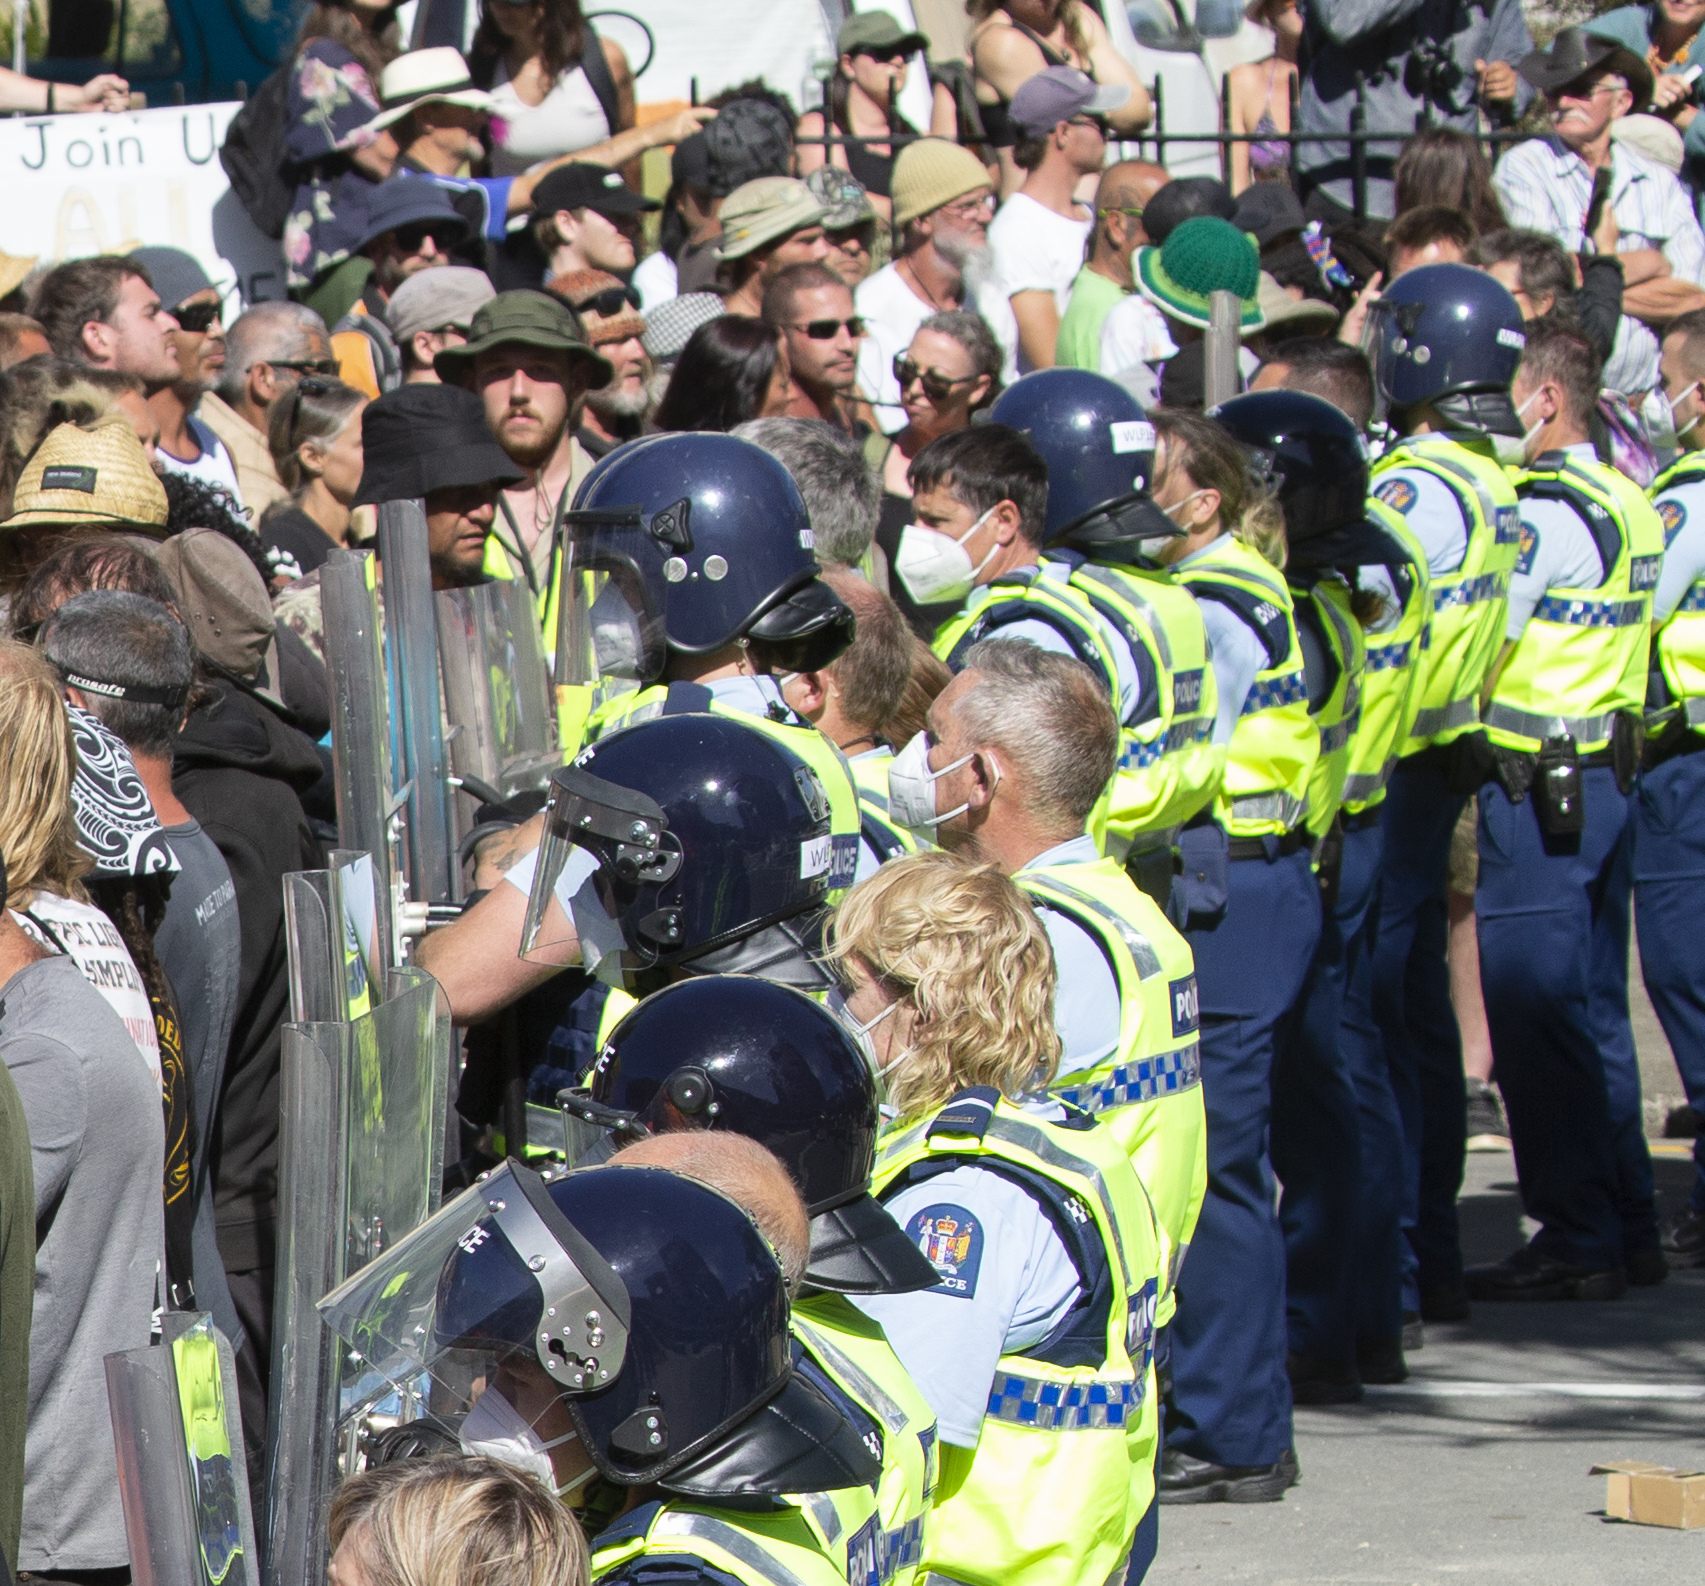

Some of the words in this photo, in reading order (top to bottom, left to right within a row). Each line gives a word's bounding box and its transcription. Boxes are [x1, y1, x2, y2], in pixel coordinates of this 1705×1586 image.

[21, 118, 144, 170] Join
[182, 112, 216, 166] U
[67, 673, 126, 698] prosafe
